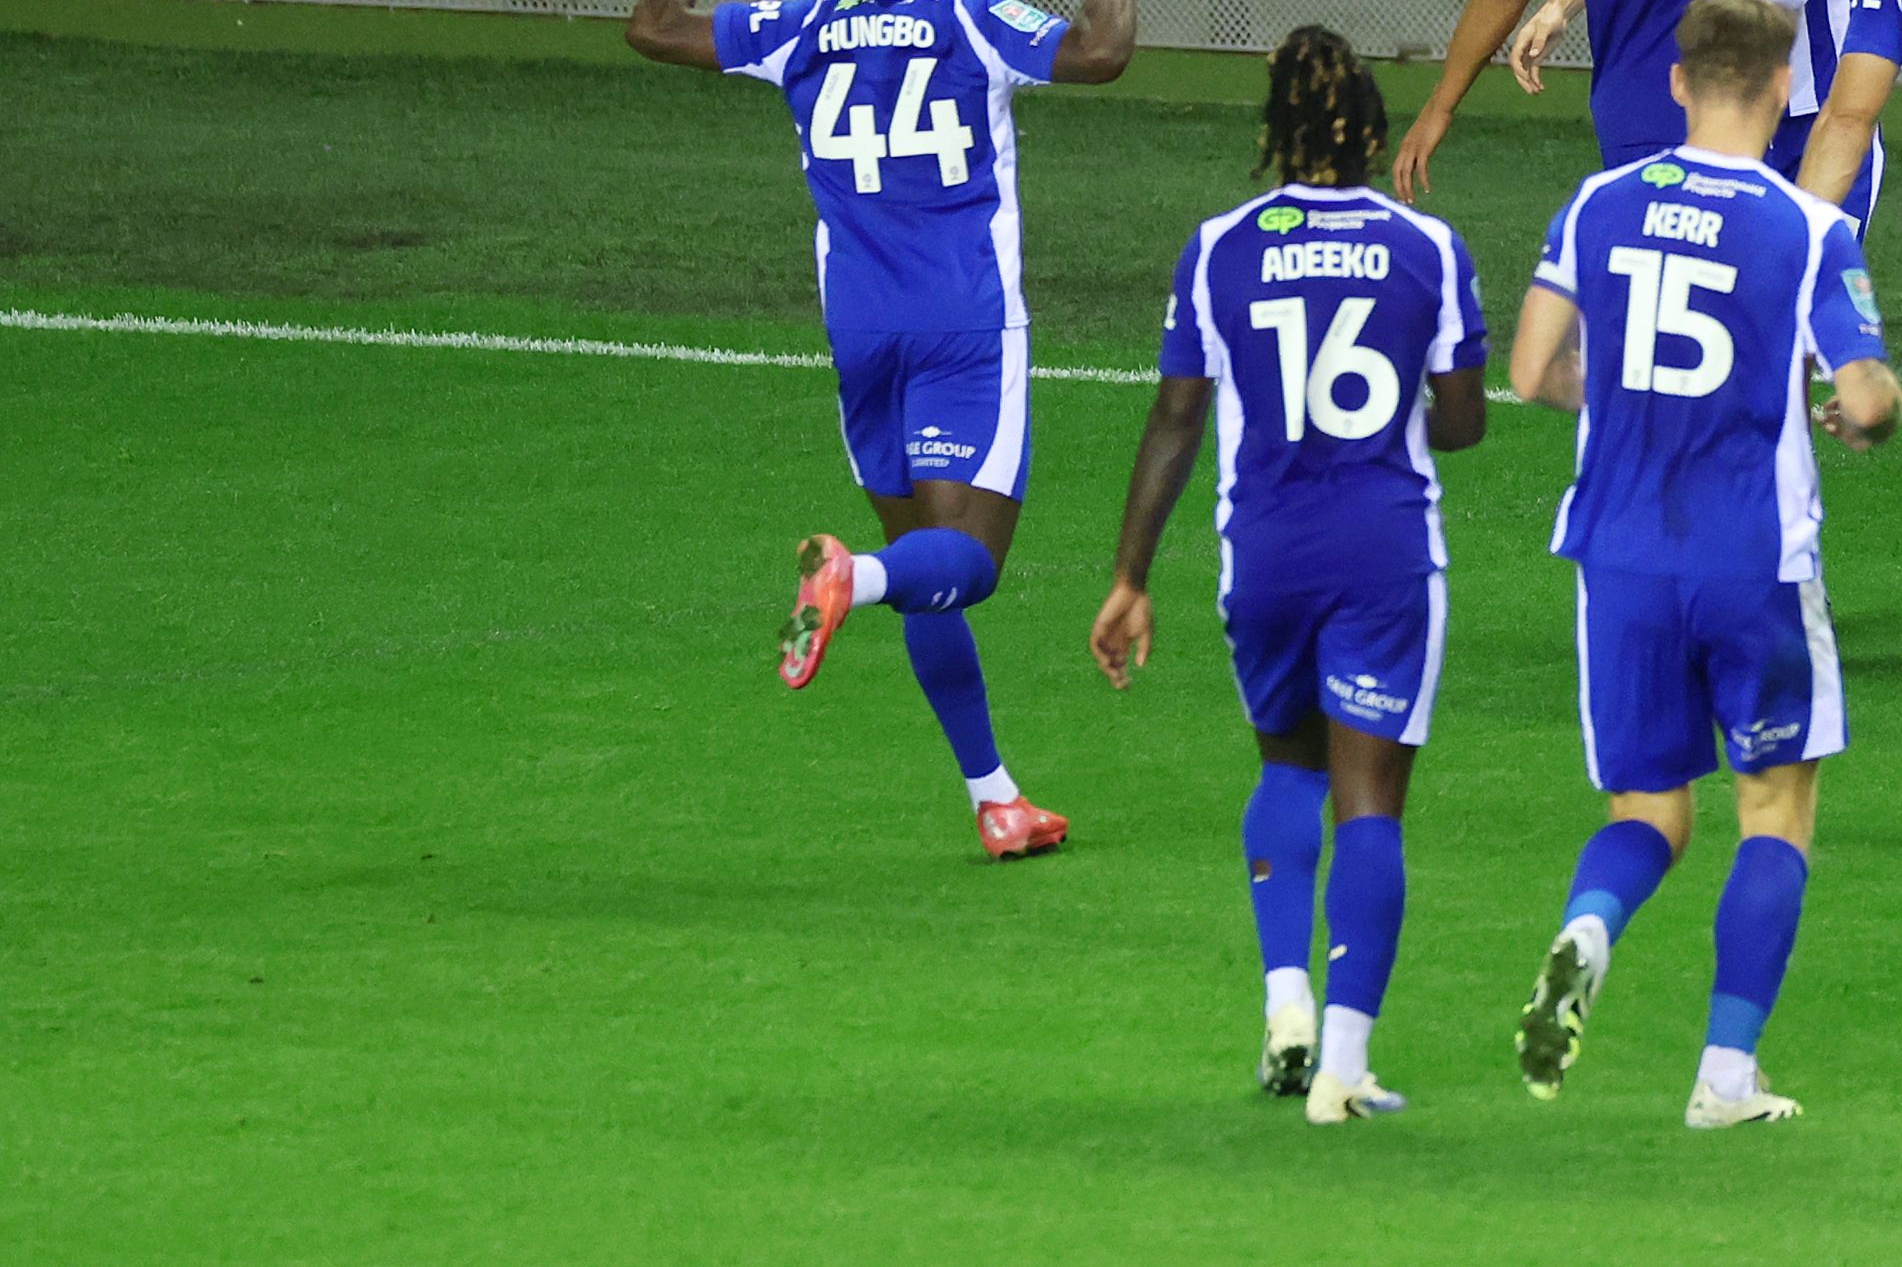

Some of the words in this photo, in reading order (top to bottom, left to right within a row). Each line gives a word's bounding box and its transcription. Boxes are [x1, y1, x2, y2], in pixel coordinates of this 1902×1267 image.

[818, 14, 935, 53] HUNGBO
[810, 57, 974, 194] 44
[1642, 201, 1725, 249] KERR
[1261, 241, 1391, 283] ADEEKO
[1608, 245, 1738, 398] 15
[1249, 295, 1400, 442] 16
[922, 441, 977, 459] GROUP
